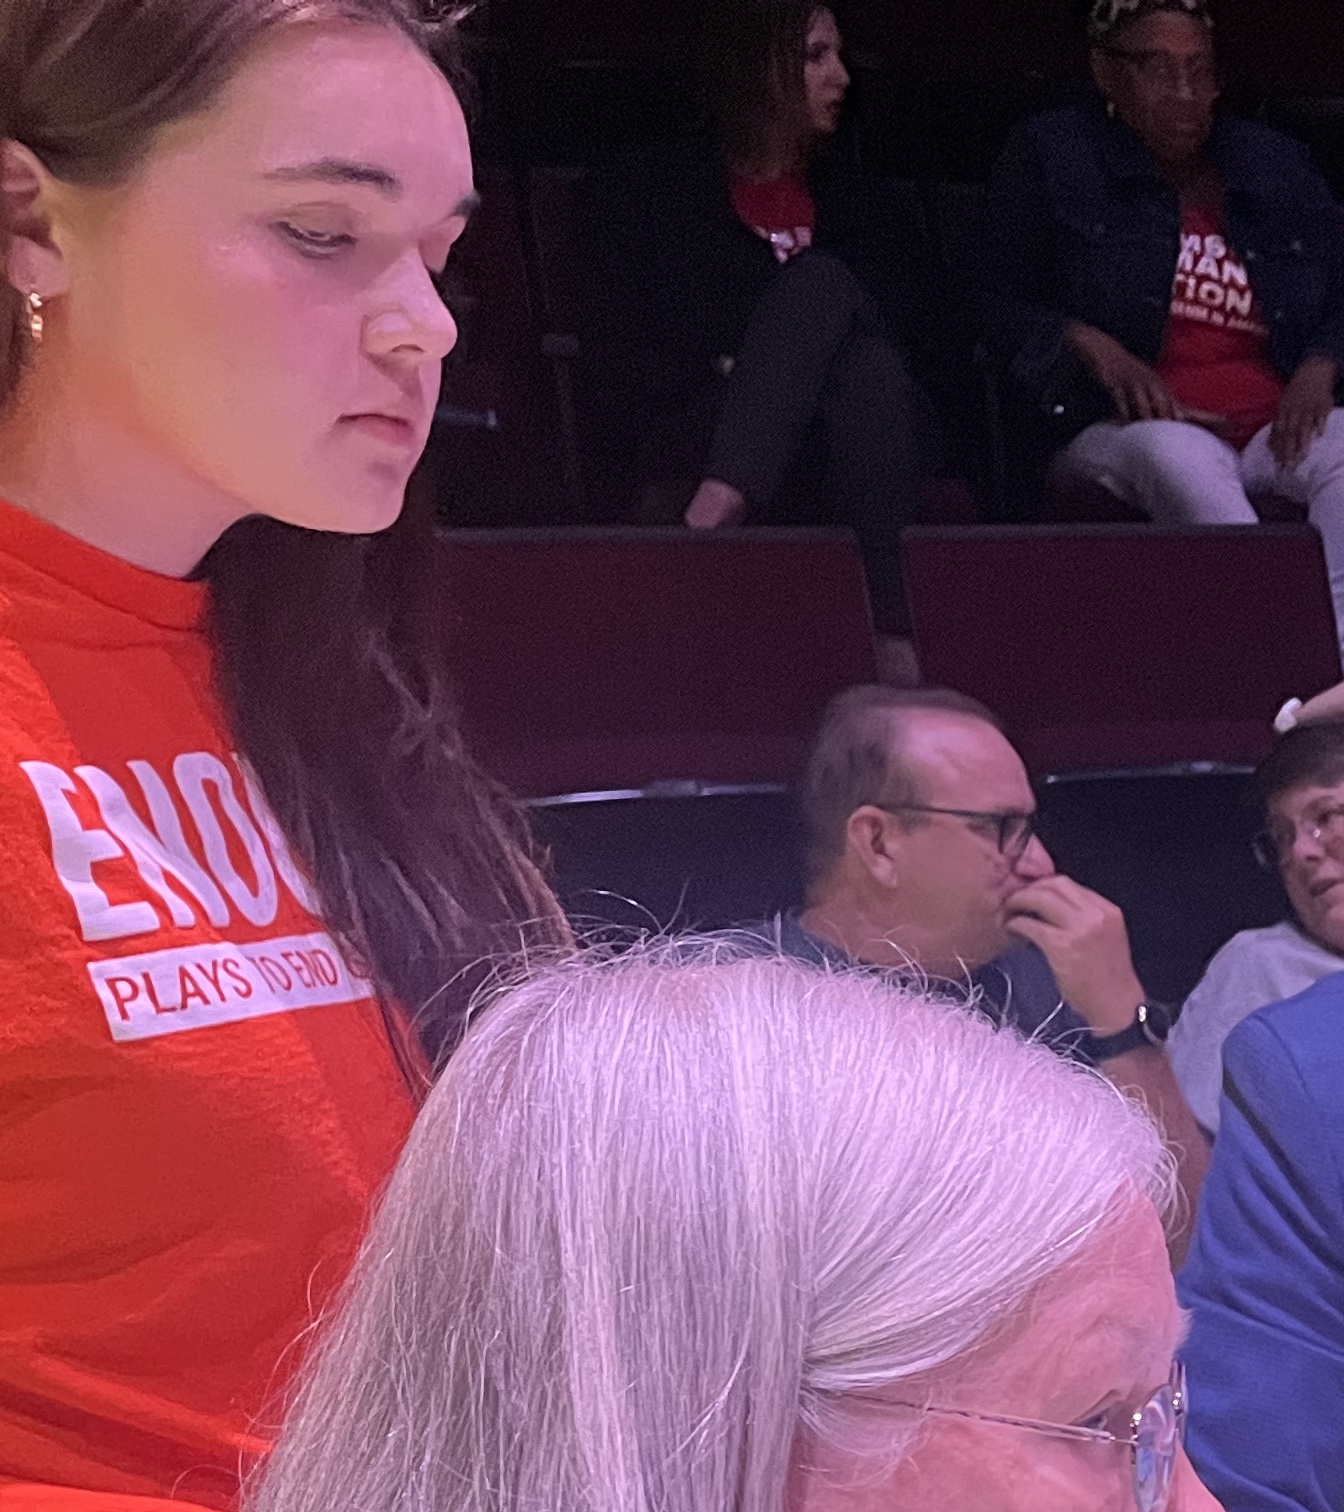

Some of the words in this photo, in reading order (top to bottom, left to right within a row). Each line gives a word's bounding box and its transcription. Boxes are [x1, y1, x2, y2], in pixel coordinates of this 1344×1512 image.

[106, 957, 253, 1021] PLAYS
[252, 954, 293, 995] TO
[293, 947, 339, 990] END
